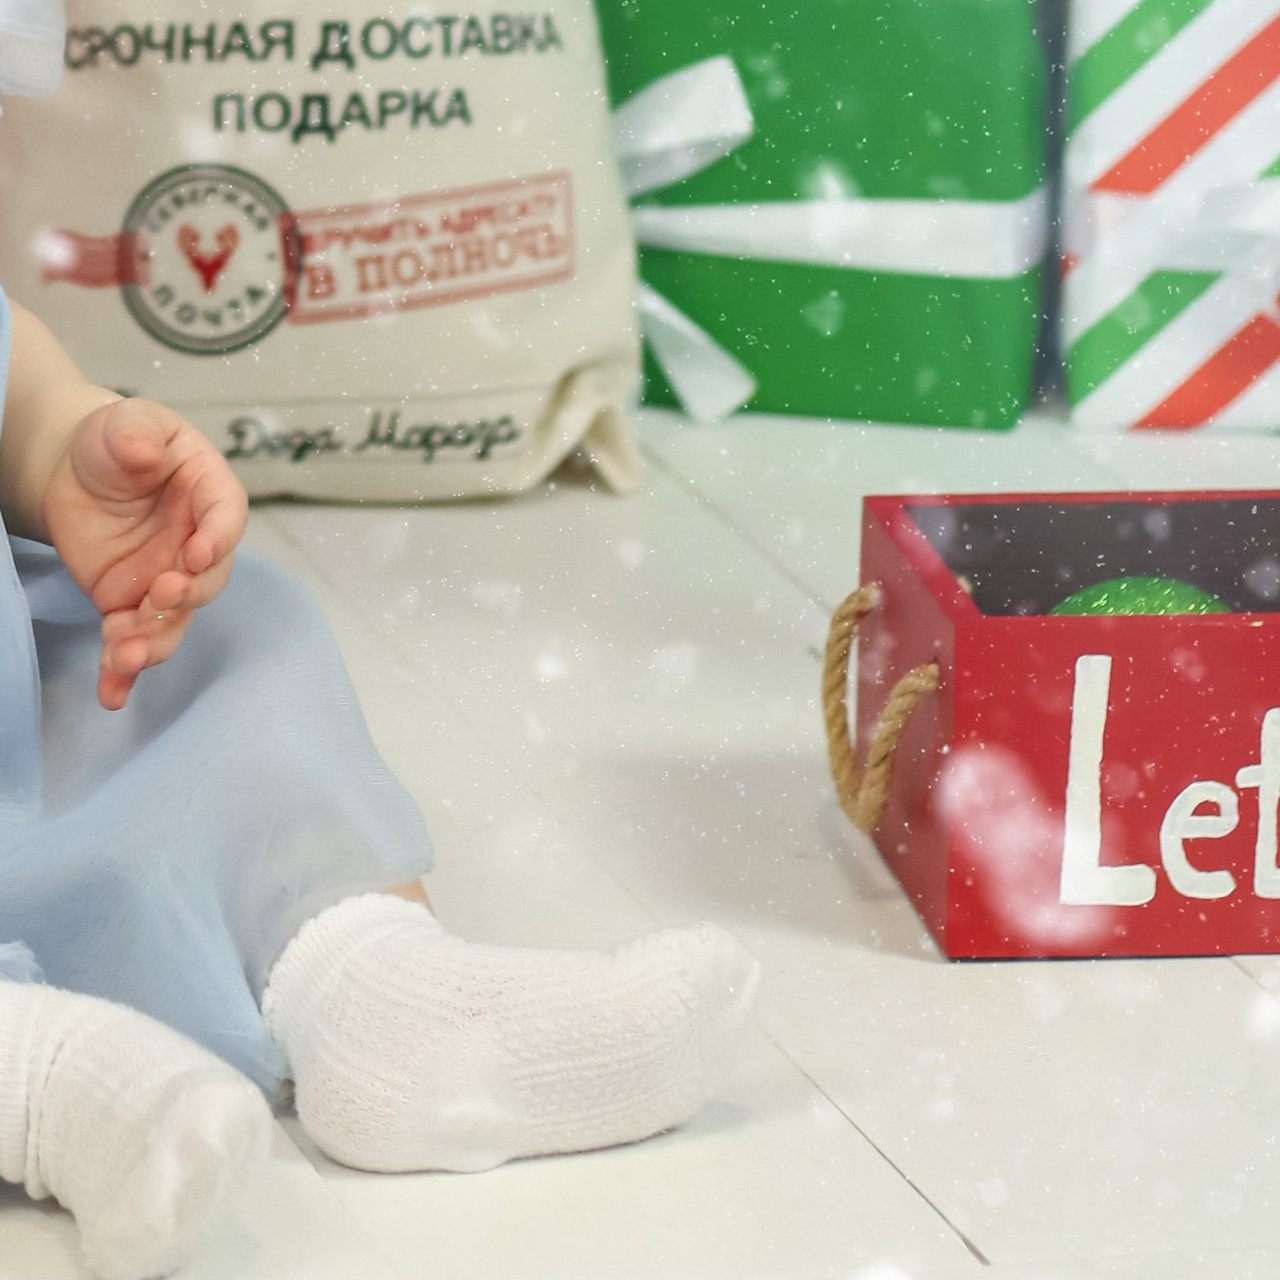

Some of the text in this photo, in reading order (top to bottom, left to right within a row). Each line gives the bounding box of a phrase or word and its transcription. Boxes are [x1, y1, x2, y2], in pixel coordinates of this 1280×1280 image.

[64, 13, 564, 71] СРОЧНАЯ ДОСТАВКА
[214, 88, 473, 144] ПОДАРКА
[304, 262, 338, 301] В
